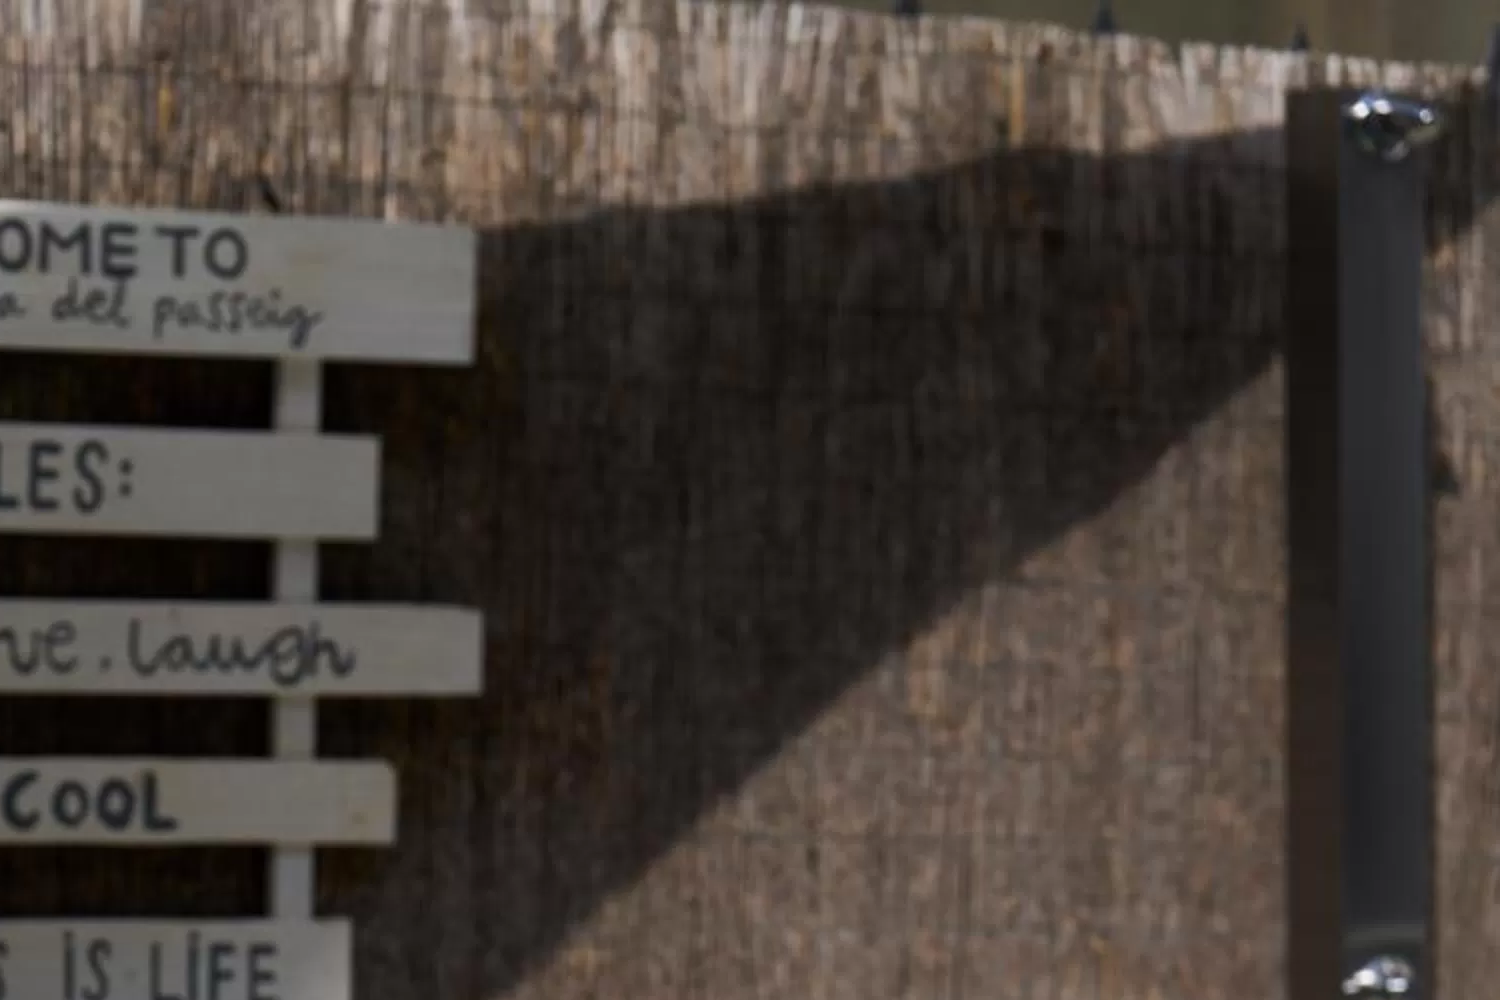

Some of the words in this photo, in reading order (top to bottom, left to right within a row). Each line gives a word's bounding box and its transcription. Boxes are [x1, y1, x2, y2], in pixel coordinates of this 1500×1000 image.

[154, 226, 249, 279] TO
[51, 275, 131, 329] del
[127, 617, 356, 687] laugh
[0, 770, 179, 832] COOL
